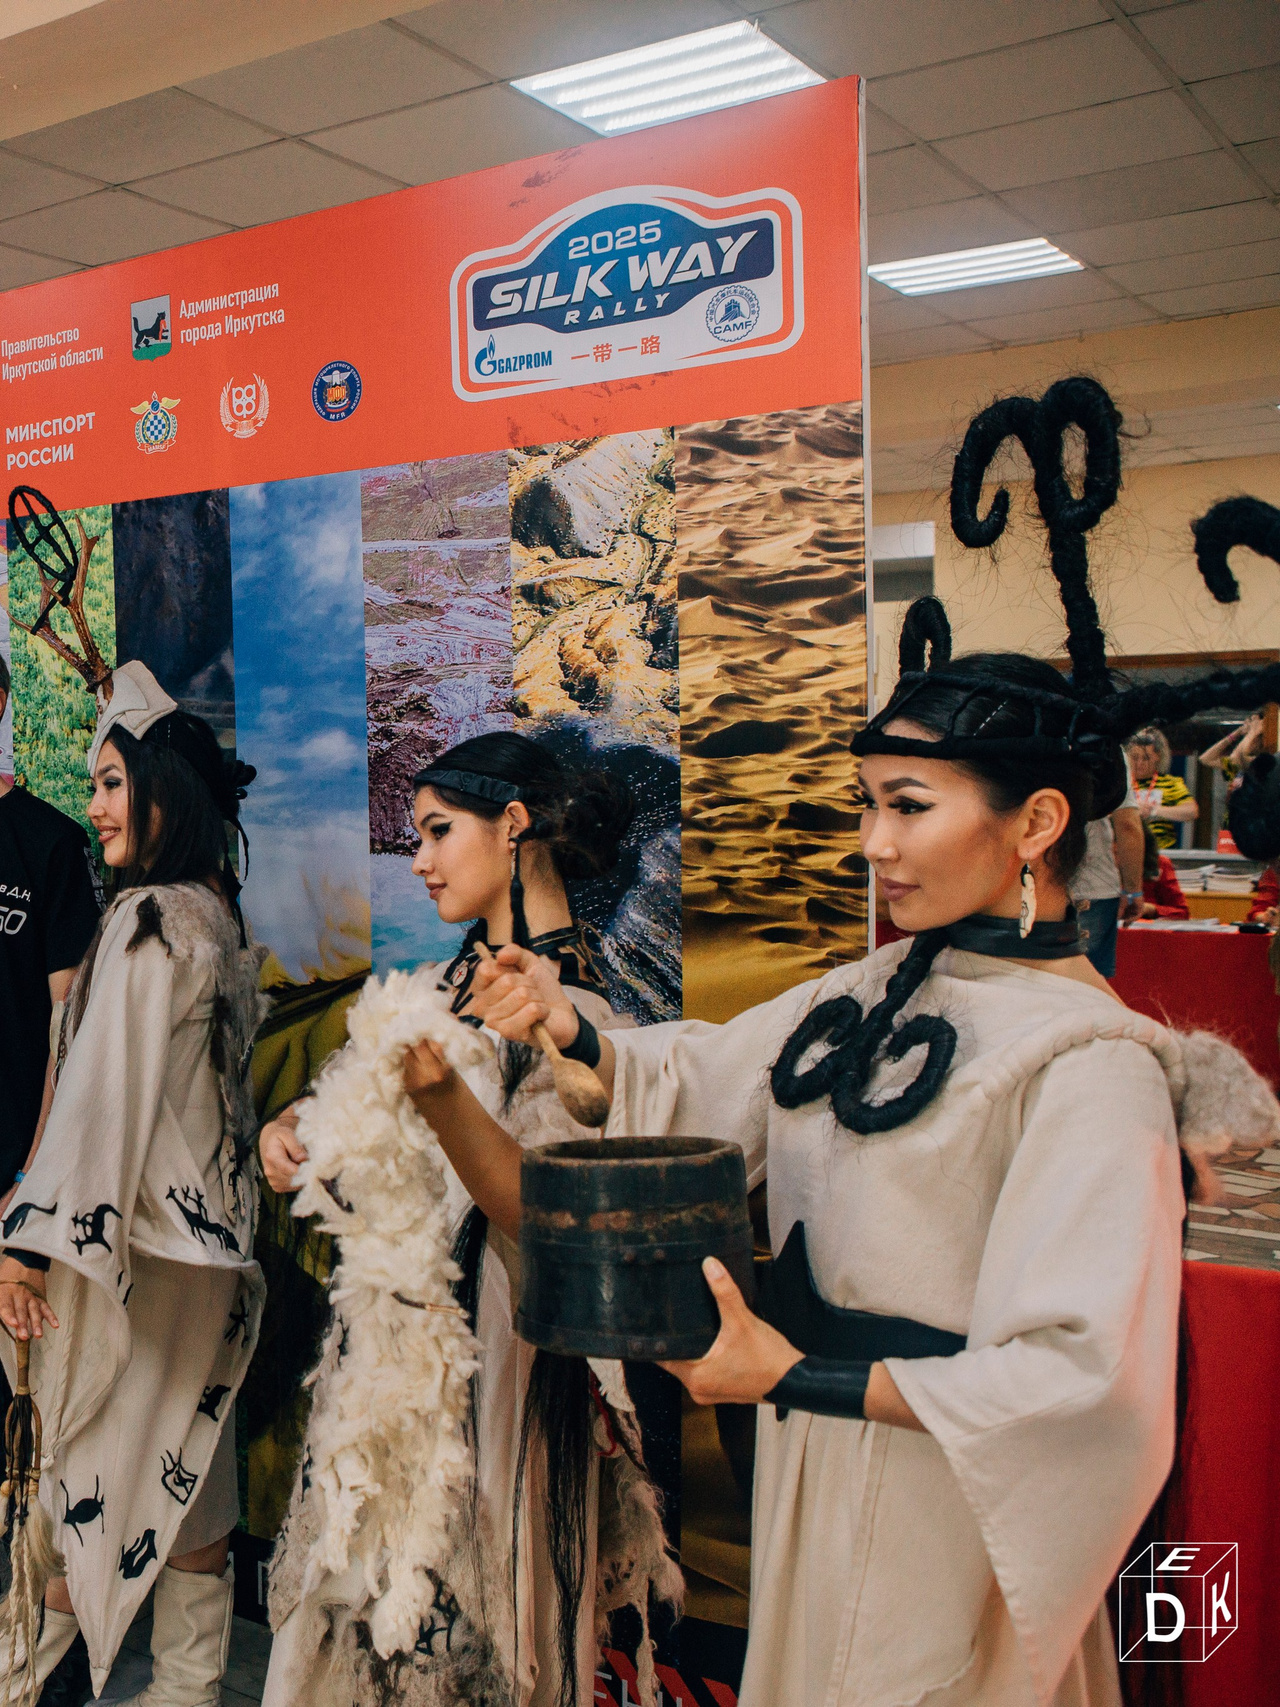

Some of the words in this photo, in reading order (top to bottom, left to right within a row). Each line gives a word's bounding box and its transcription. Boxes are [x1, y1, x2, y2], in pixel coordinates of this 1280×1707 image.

[568, 219, 661, 260] 2025
[486, 259, 619, 320] SILK
[627, 230, 758, 292] WAY
[179, 283, 279, 319] Администрация
[564, 292, 670, 326] RALLY
[1, 327, 80, 360] Правительство
[180, 321, 222, 346] города
[224, 308, 285, 336] Иркутска
[713, 320, 752, 335] CAMF
[2, 356, 58, 383] Иркутской
[59, 347, 104, 369] области
[498, 350, 552, 375] GAZPROM
[571, 335, 661, 362] 一带一路
[5, 412, 96, 444] МИНСПОРТ
[329, 411, 346, 420] MFR
[6, 443, 74, 471] РОССИИ
